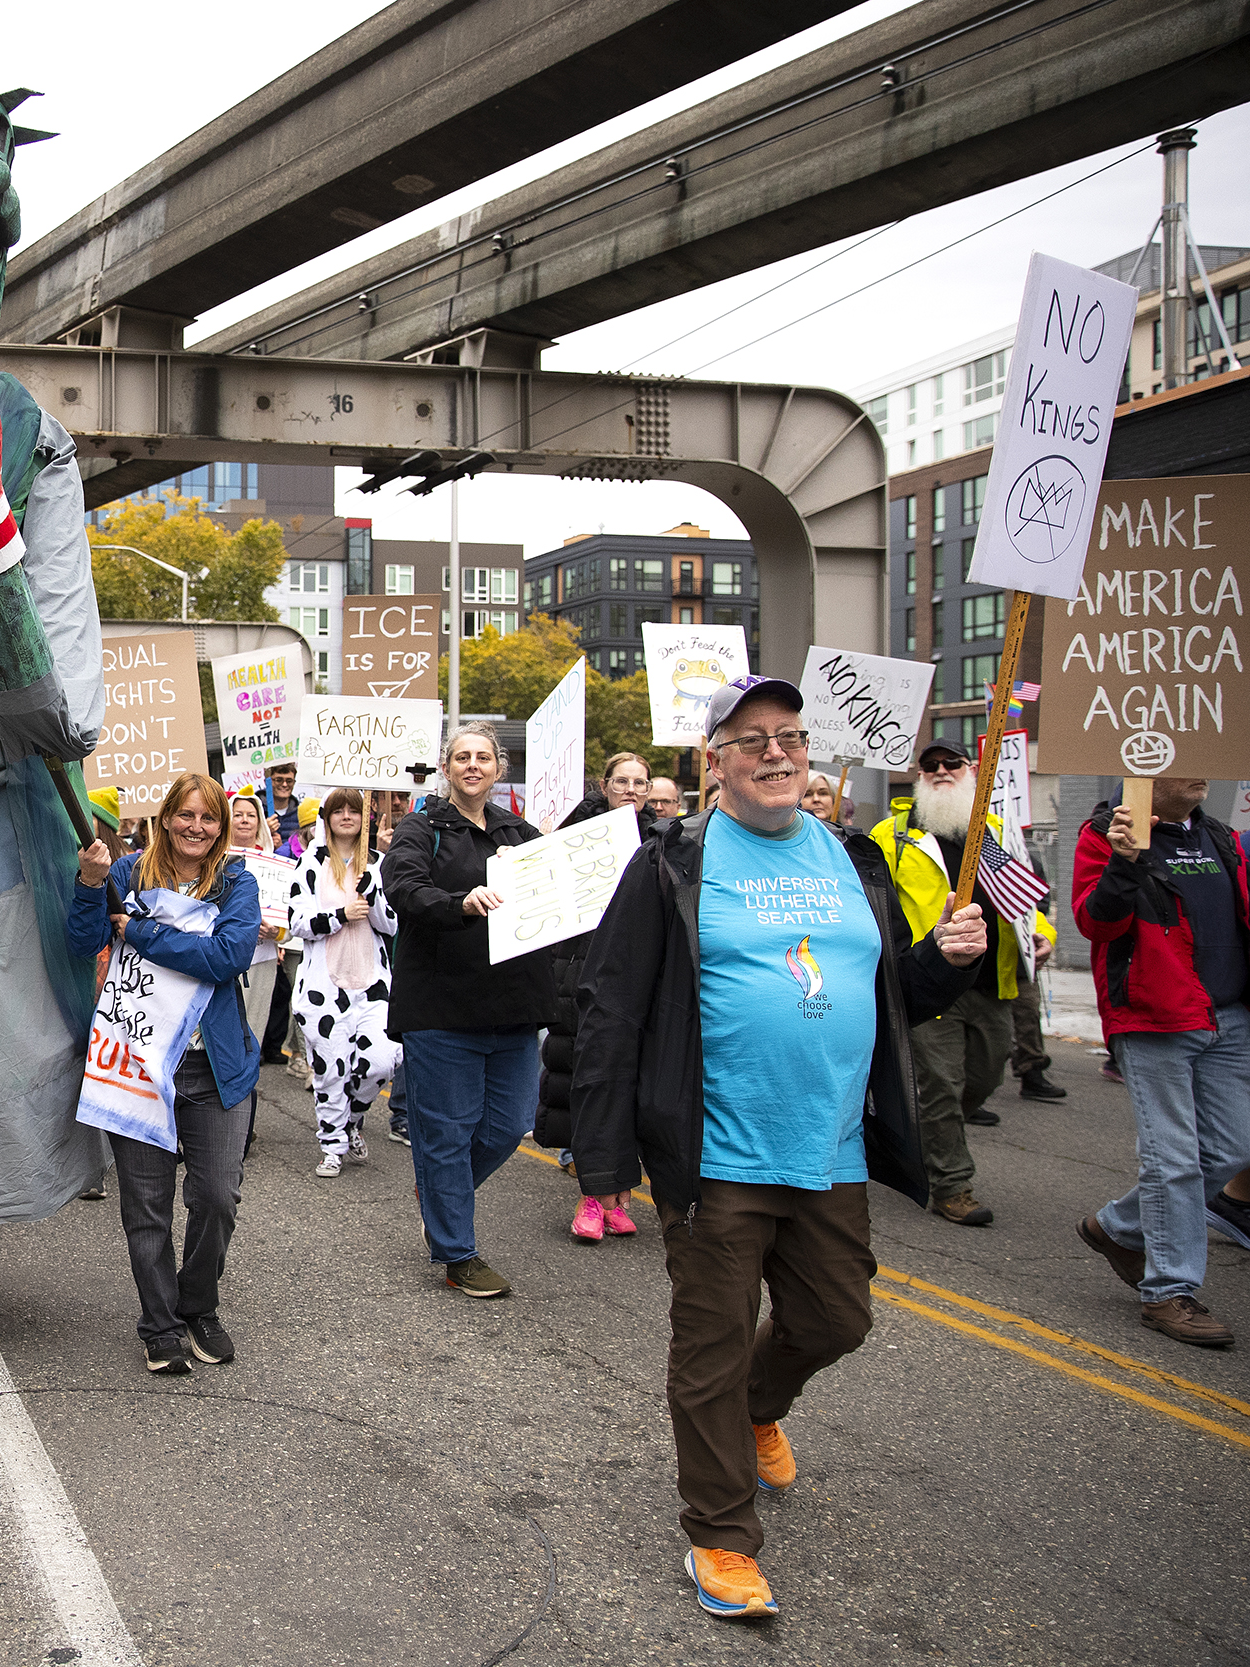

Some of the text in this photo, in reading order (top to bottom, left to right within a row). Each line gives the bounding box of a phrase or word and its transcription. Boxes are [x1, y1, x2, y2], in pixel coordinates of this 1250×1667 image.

[1043, 288, 1105, 364] NO
[333, 394, 354, 413] 16
[1020, 363, 1100, 444] KINGS
[1098, 493, 1217, 550] MAKE
[1067, 566, 1243, 617] AMERICA
[348, 605, 433, 639] ICE
[102, 643, 168, 671] QUAL
[345, 651, 431, 671] IS FOR
[658, 636, 735, 661] Don't Feed the
[1062, 625, 1243, 675] AMERICA
[227, 656, 287, 691] HEALTH
[819, 655, 858, 696] NO
[105, 678, 176, 709] IGHTS
[236, 685, 286, 711] CARE
[252, 706, 282, 723] NOT
[532, 671, 580, 743] STAND
[1083, 682, 1223, 733] AGAIN
[317, 709, 406, 738] FARTING
[672, 715, 707, 731] Fasc
[808, 718, 845, 732] UNLESS
[223, 729, 280, 757] WEALTH
[349, 739, 371, 754] ON
[544, 721, 563, 759] UP
[811, 736, 840, 752] BOW
[96, 749, 187, 778] ERODE
[323, 752, 399, 778] FACISTS
[533, 738, 577, 811] FIGHT
[258, 865, 287, 883] THE
[1169, 862, 1222, 875] XLVIII
[261, 889, 291, 904] PLE
[736, 877, 839, 892] UNIVERSITY
[746, 894, 843, 909] LUTHERAN
[757, 910, 842, 924] SEATTLE
[797, 1000, 833, 1011] choose
[803, 1009, 824, 1020] love
